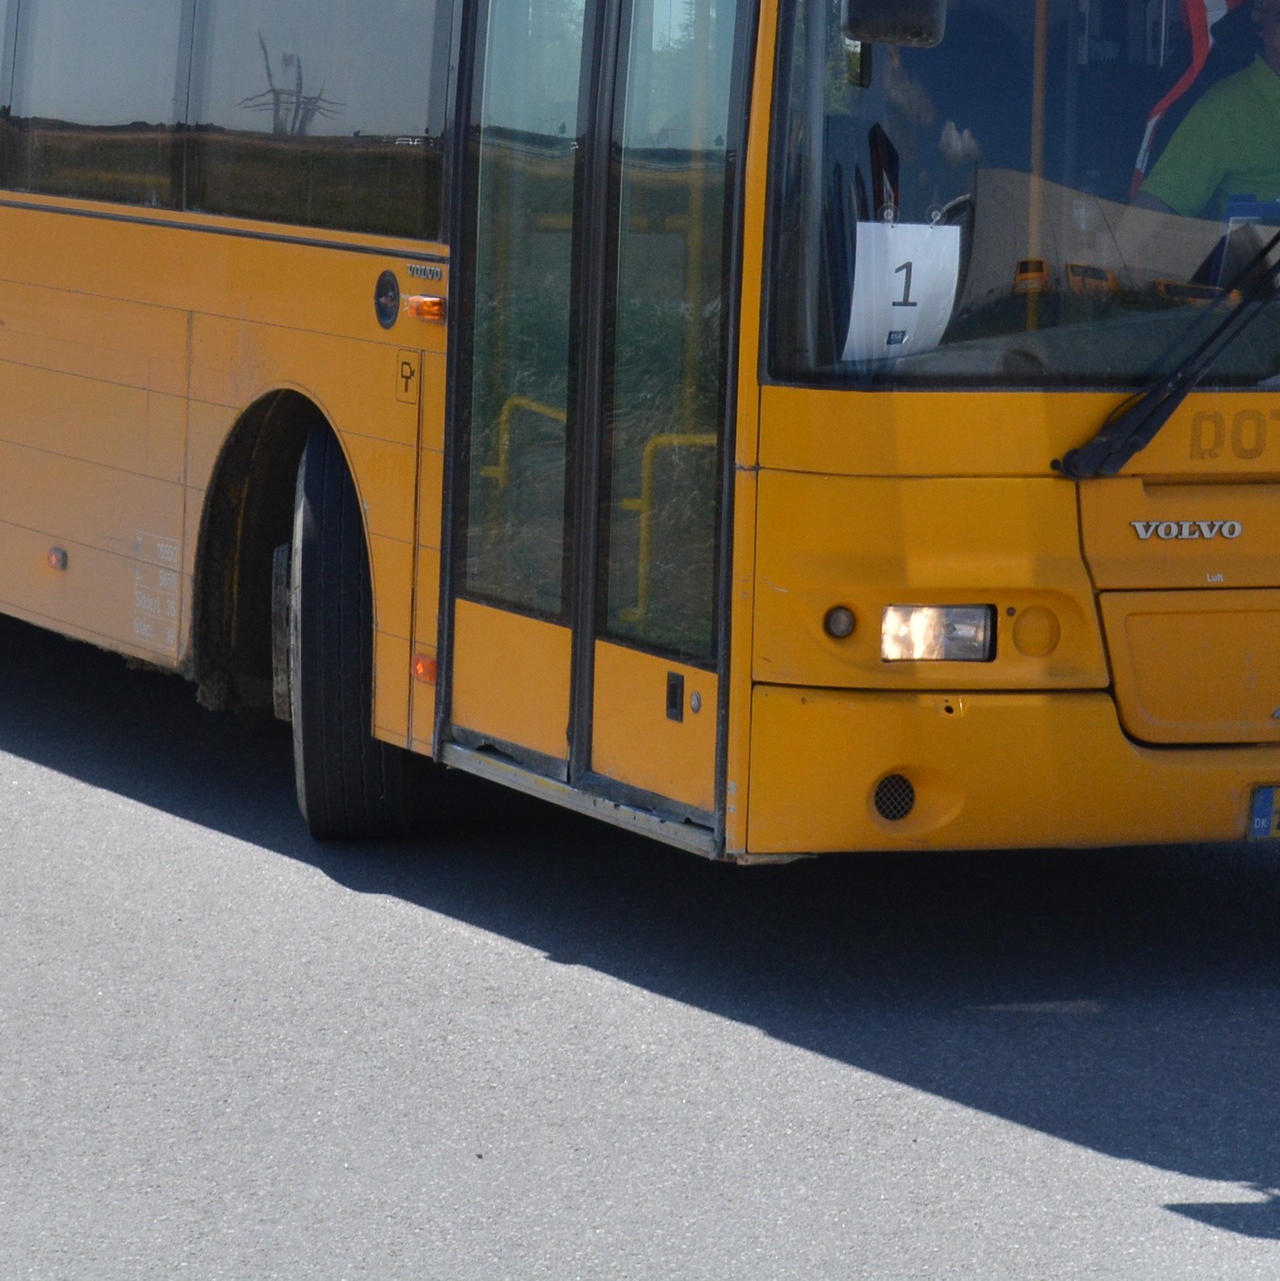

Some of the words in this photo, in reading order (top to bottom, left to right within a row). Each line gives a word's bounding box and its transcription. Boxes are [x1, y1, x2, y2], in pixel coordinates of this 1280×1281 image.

[407, 264, 442, 281] VOLVO
[892, 261, 918, 307] 1
[1130, 520, 1243, 540] VOLVO
[1206, 572, 1224, 583] Luft
[1254, 818, 1268, 829] DK
